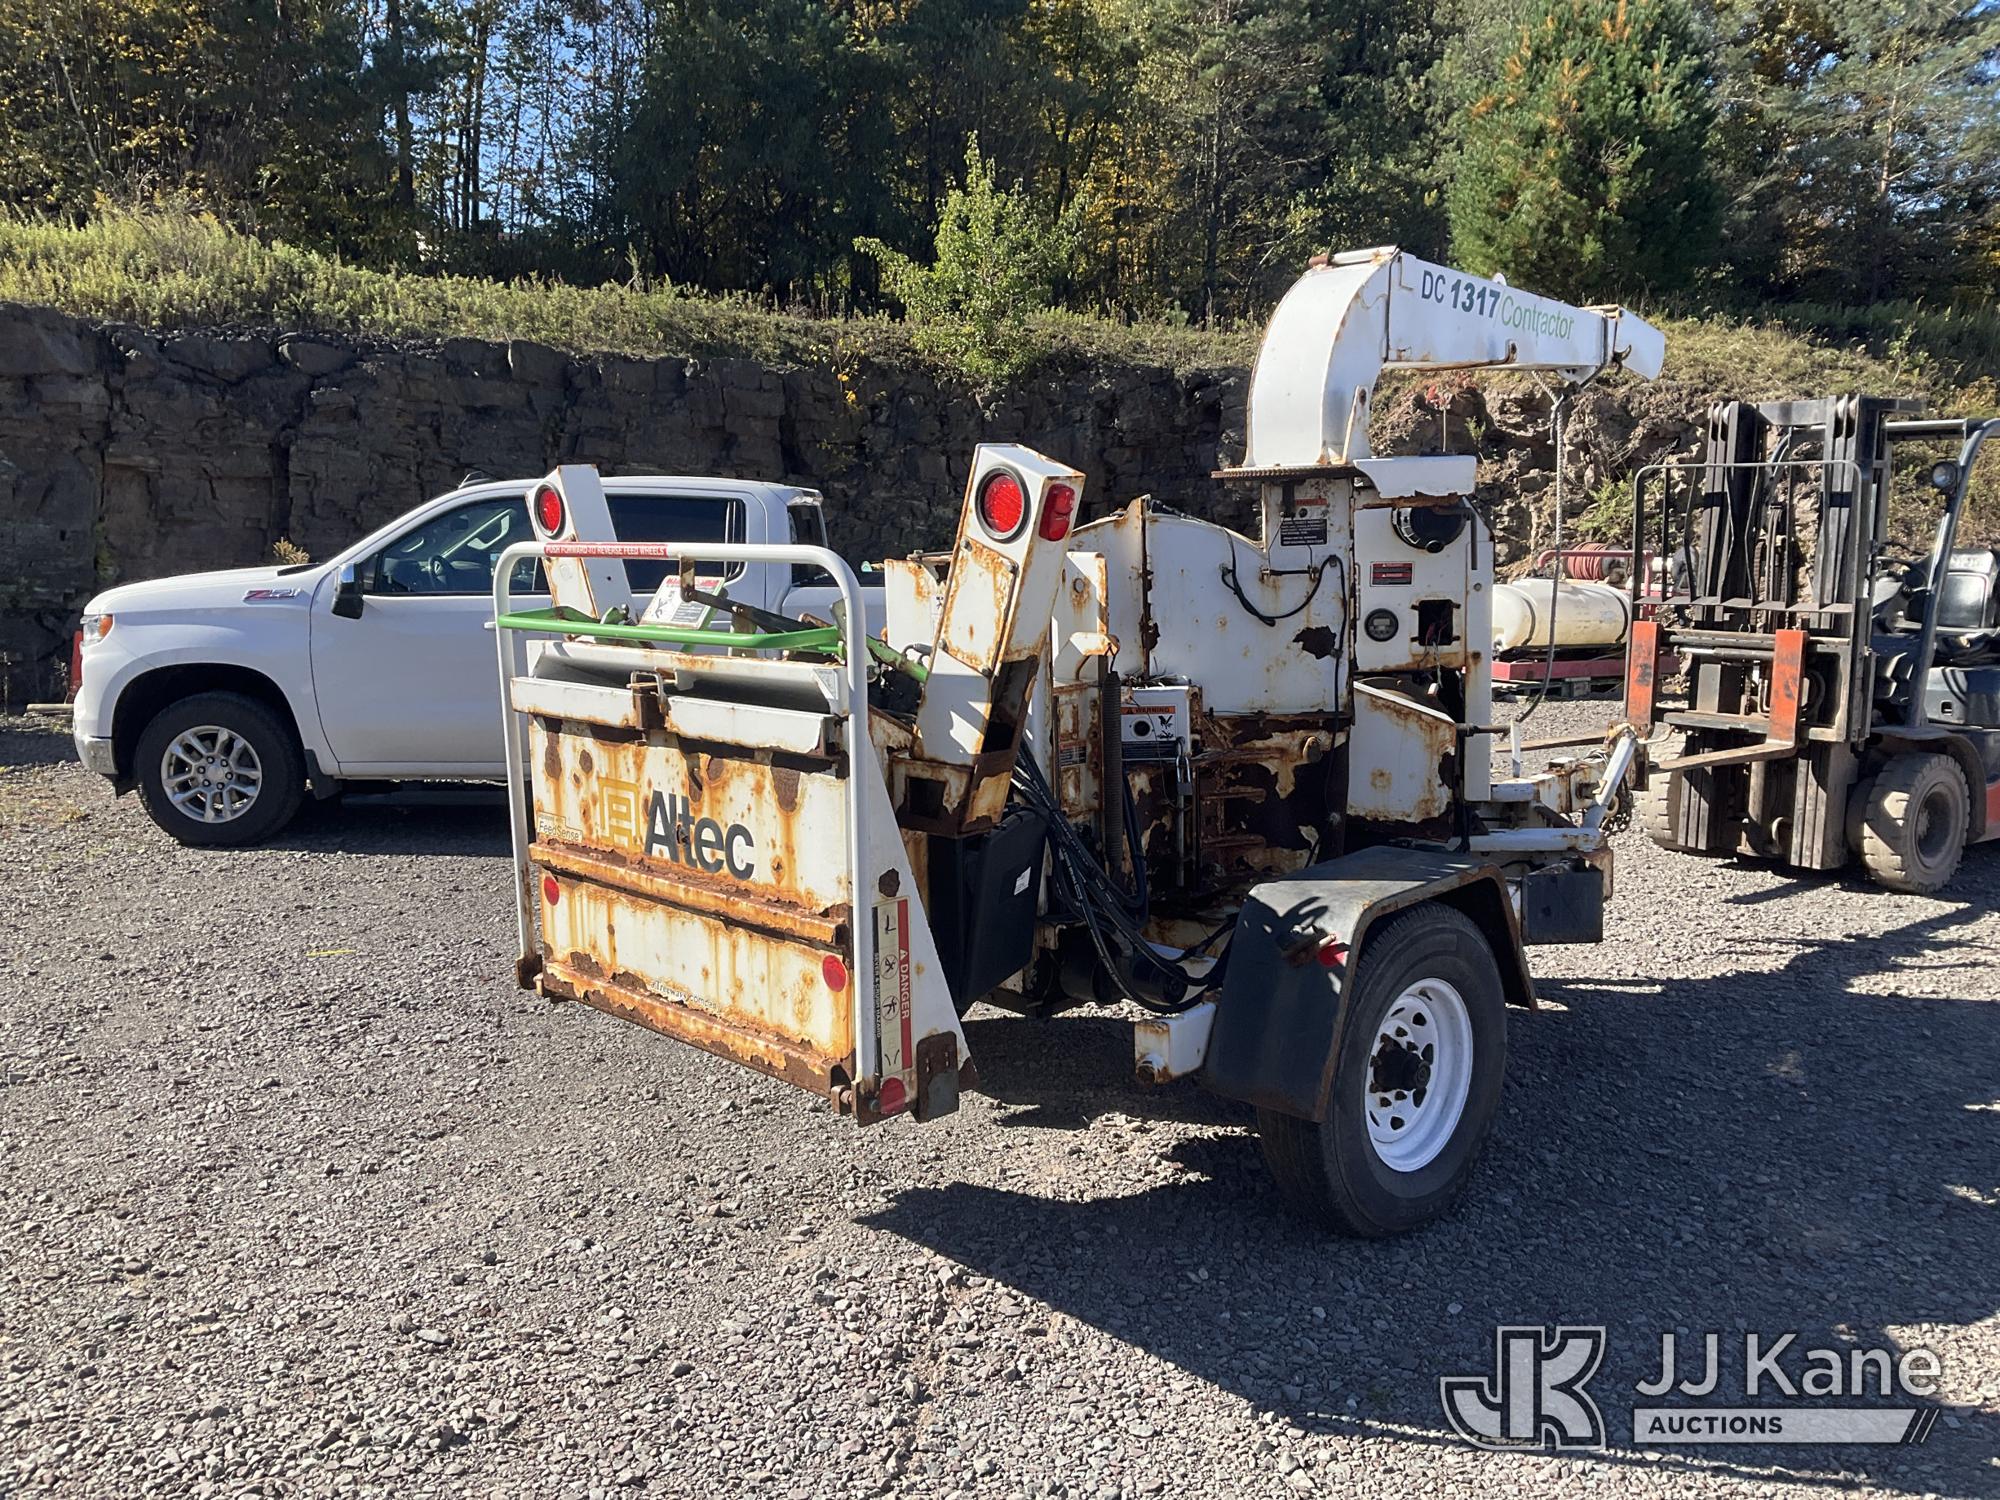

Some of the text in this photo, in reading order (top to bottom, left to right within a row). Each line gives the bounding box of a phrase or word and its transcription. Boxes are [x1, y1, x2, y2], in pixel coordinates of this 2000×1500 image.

[1421, 269, 1575, 341] DC 1317 Contractor
[545, 546, 561, 555] PUSH
[598, 546, 623, 556] REVERSE
[624, 547, 639, 556] FEED
[640, 547, 665, 556] WHEELS
[644, 789, 755, 880] Altec
[899, 965, 910, 1020] DANGER
